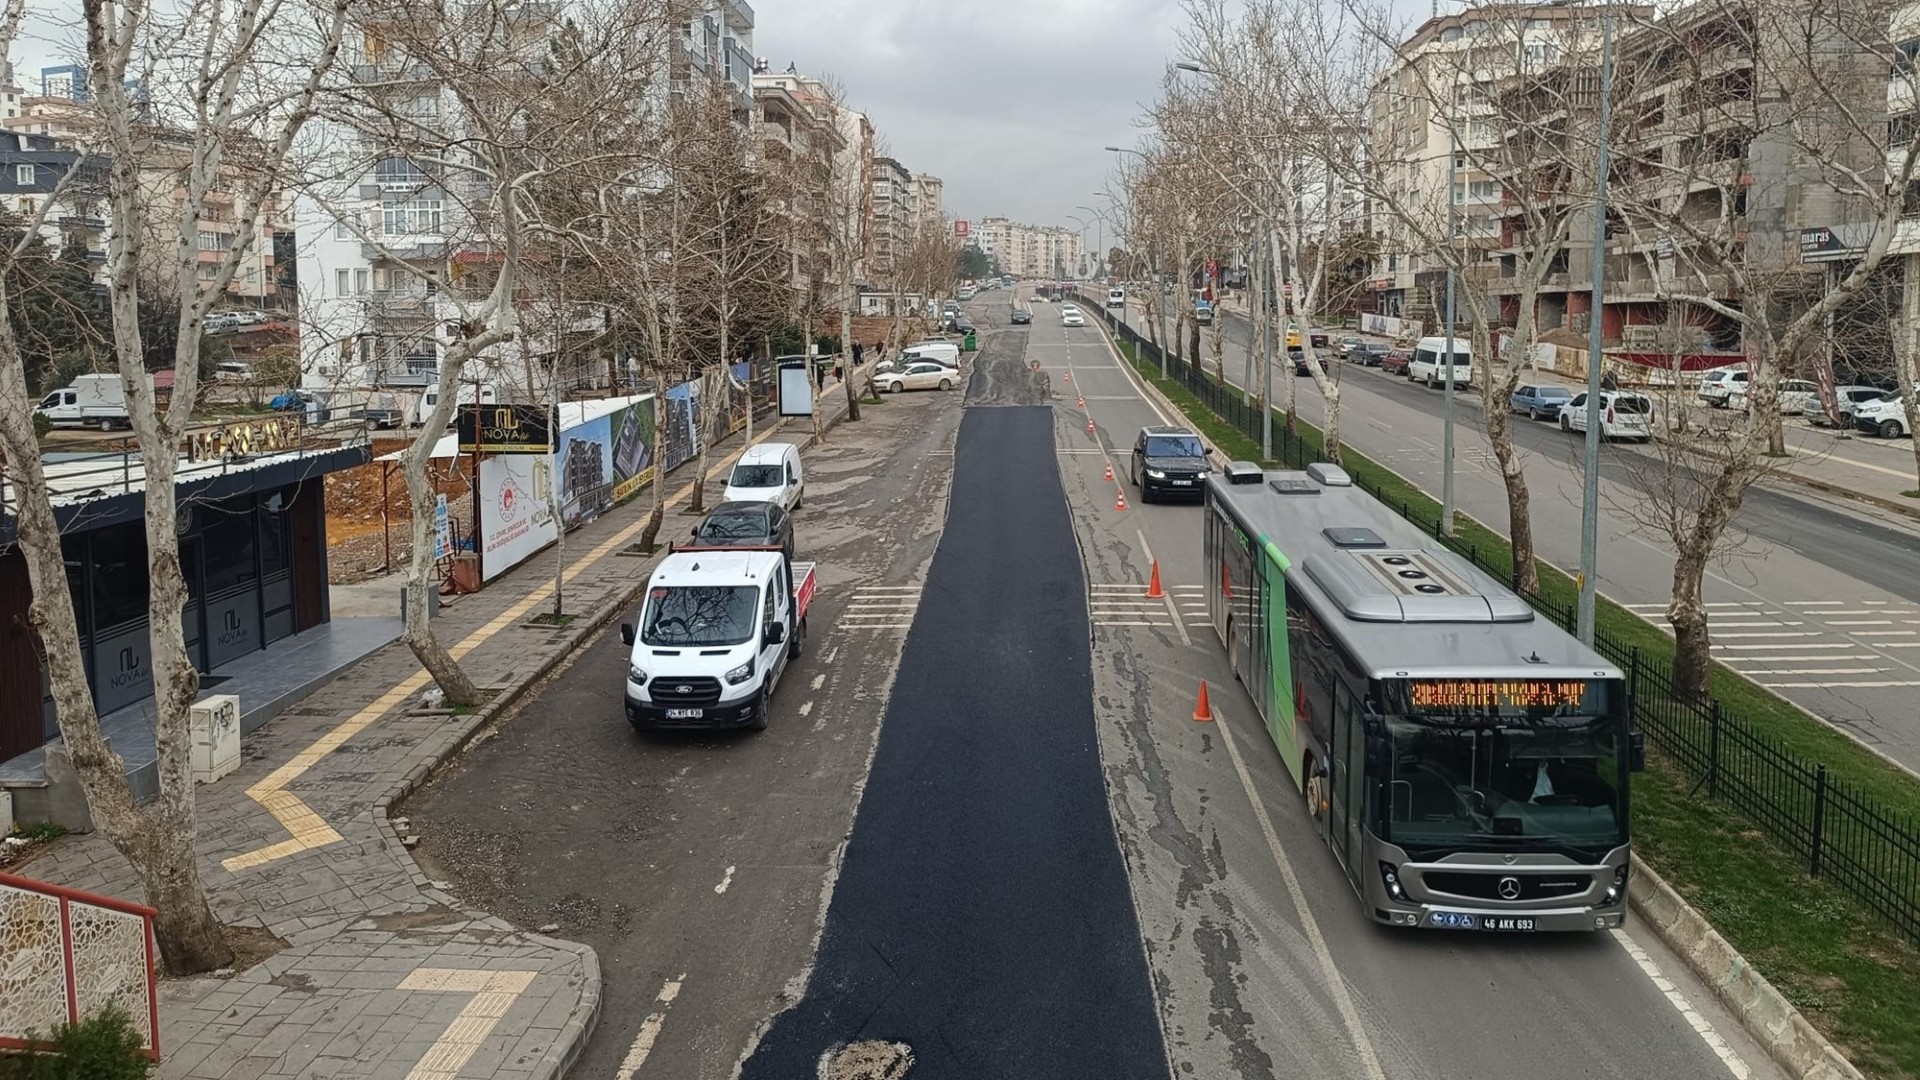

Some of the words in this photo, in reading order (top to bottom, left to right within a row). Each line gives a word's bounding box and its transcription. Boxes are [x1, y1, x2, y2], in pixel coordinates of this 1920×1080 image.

[484, 428, 519, 440] NOVA
[218, 632, 240, 646] NOVA
[111, 668, 140, 689] NOVA
[1484, 918, 1495, 929] 46
[1499, 919, 1515, 930] AKK
[1517, 919, 1534, 930] 693
